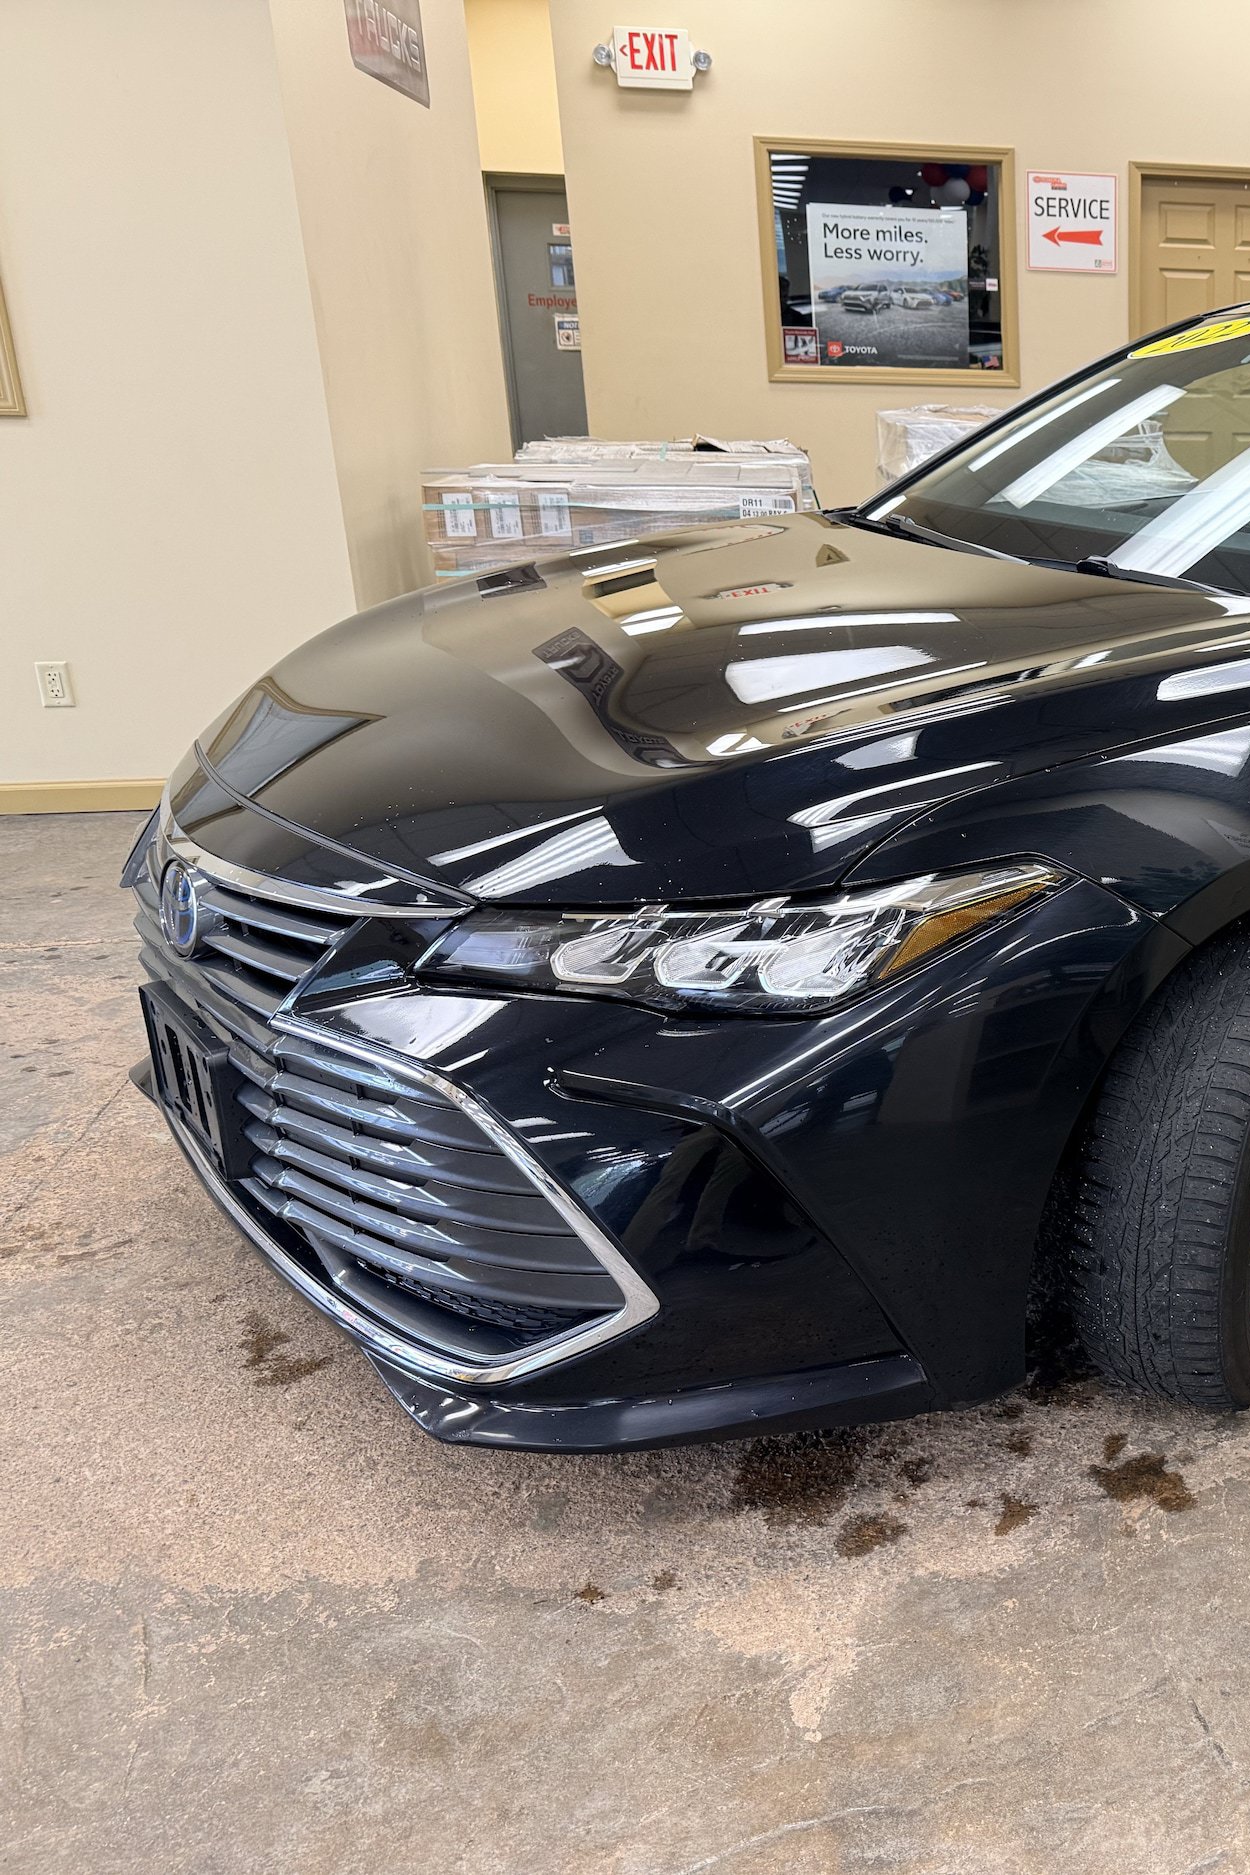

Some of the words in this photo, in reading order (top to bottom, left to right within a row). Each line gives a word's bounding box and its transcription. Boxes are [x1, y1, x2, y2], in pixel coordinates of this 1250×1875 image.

[628, 32, 678, 71] EXIT
[1034, 196, 1110, 220] SERVICE
[823, 223, 870, 240] More
[876, 226, 928, 244] miles.
[824, 243, 863, 260] Less
[868, 248, 924, 266] worry.
[844, 346, 878, 354] TOYOTA
[742, 498, 762, 507] DR11
